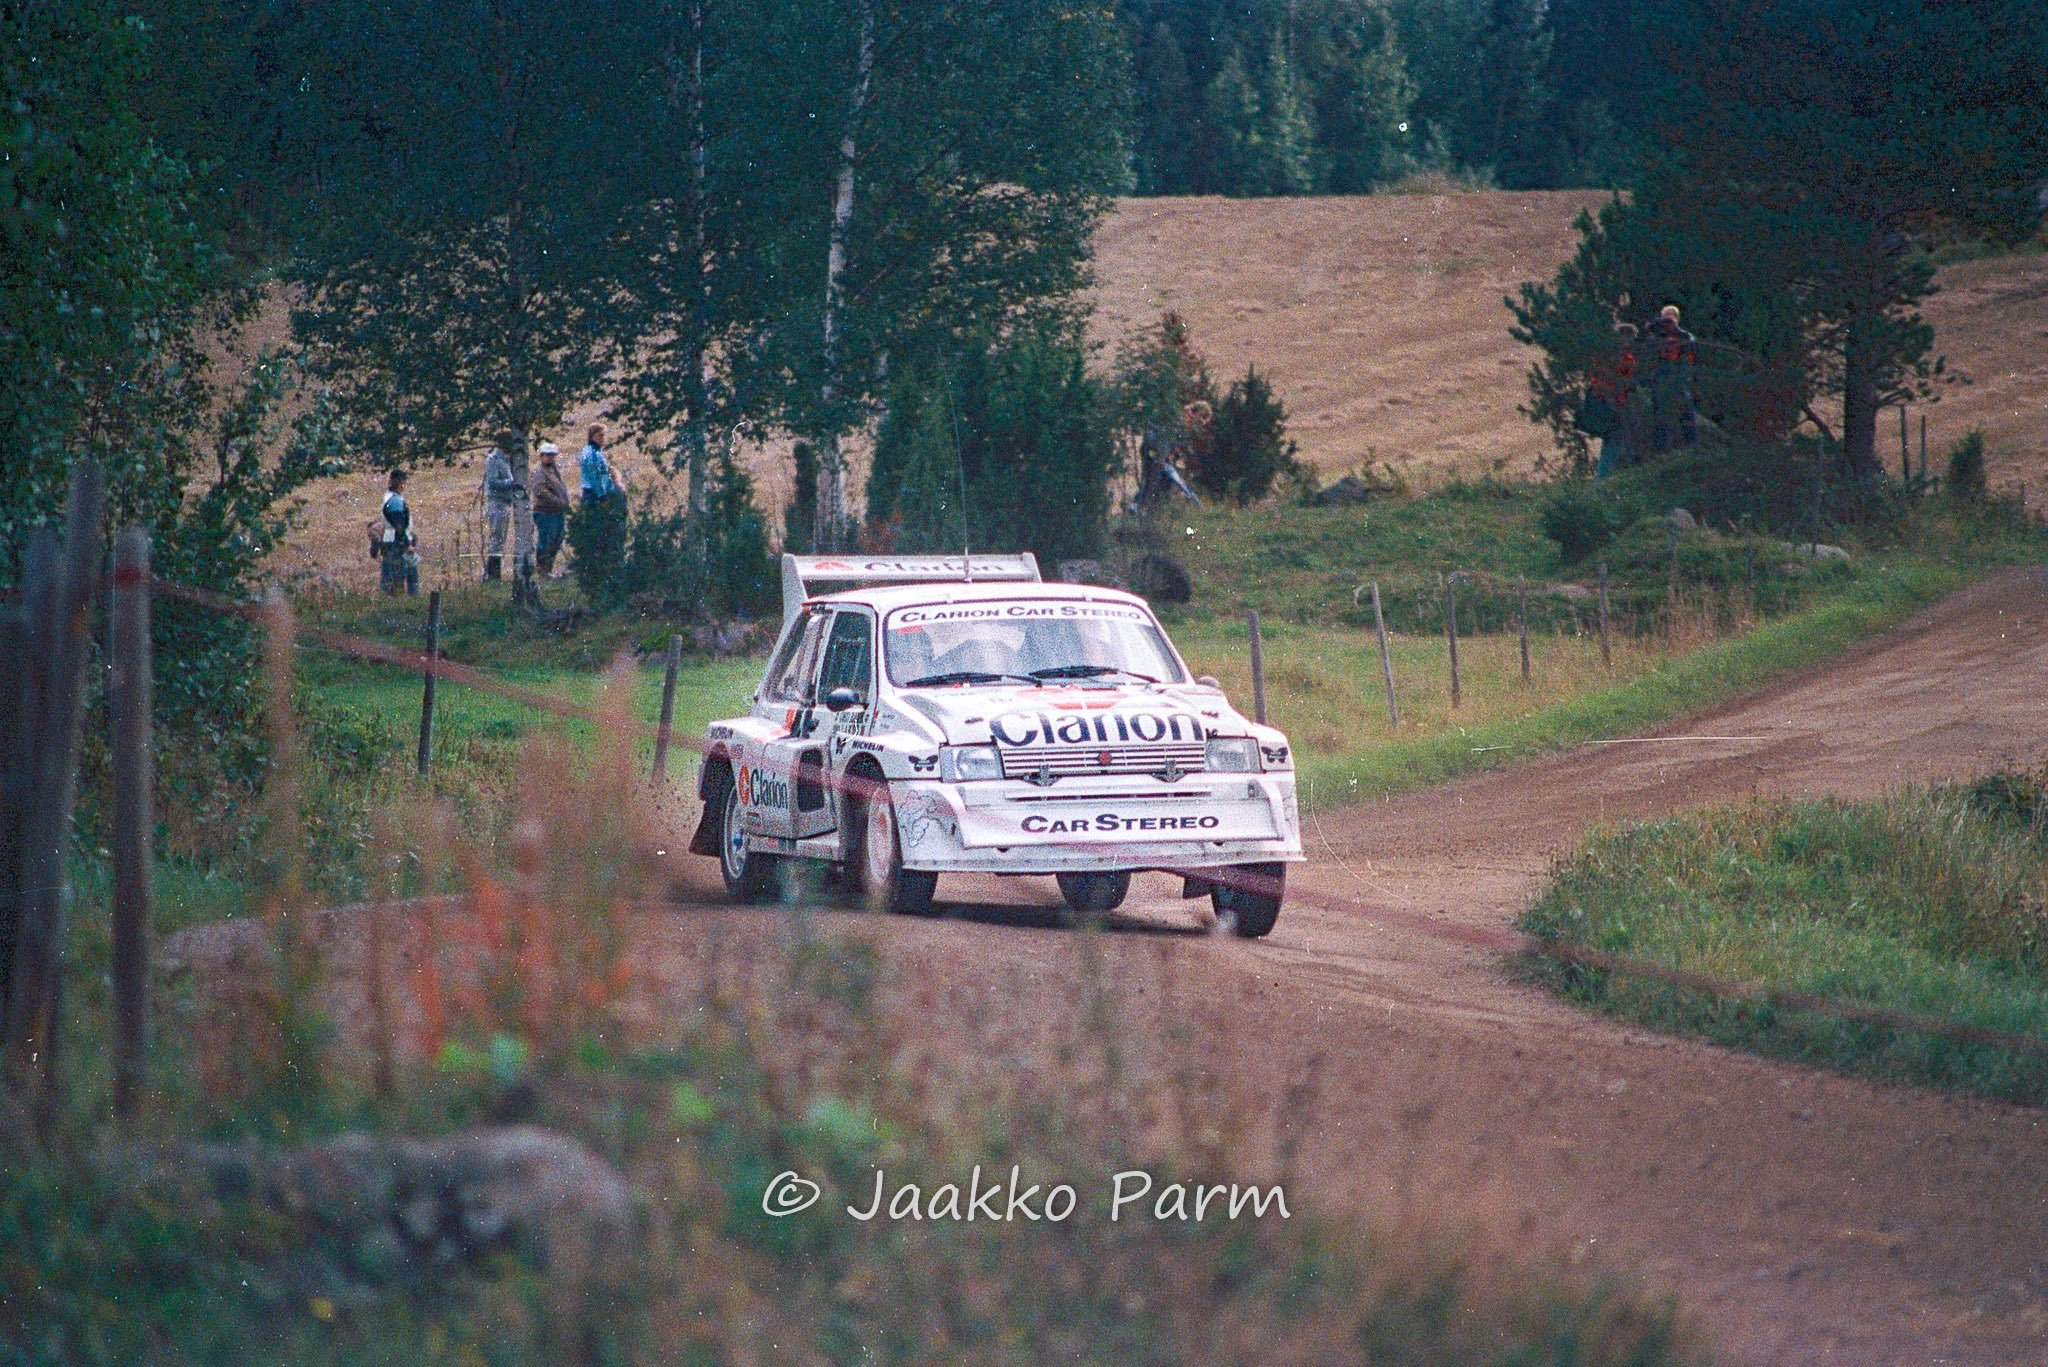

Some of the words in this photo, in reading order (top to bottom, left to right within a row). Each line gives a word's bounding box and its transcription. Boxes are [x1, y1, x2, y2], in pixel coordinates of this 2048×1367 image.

[865, 561, 1006, 573] Clarion
[900, 606, 1000, 622] CLARION
[1006, 606, 1054, 617] CAR
[1060, 606, 1142, 620] STEREO
[990, 712, 1204, 747] Clarion
[851, 739, 885, 752] MICHELIN
[750, 768, 789, 809] Clarion
[1021, 815, 1090, 833] CAR
[1095, 812, 1220, 832] STEREO
